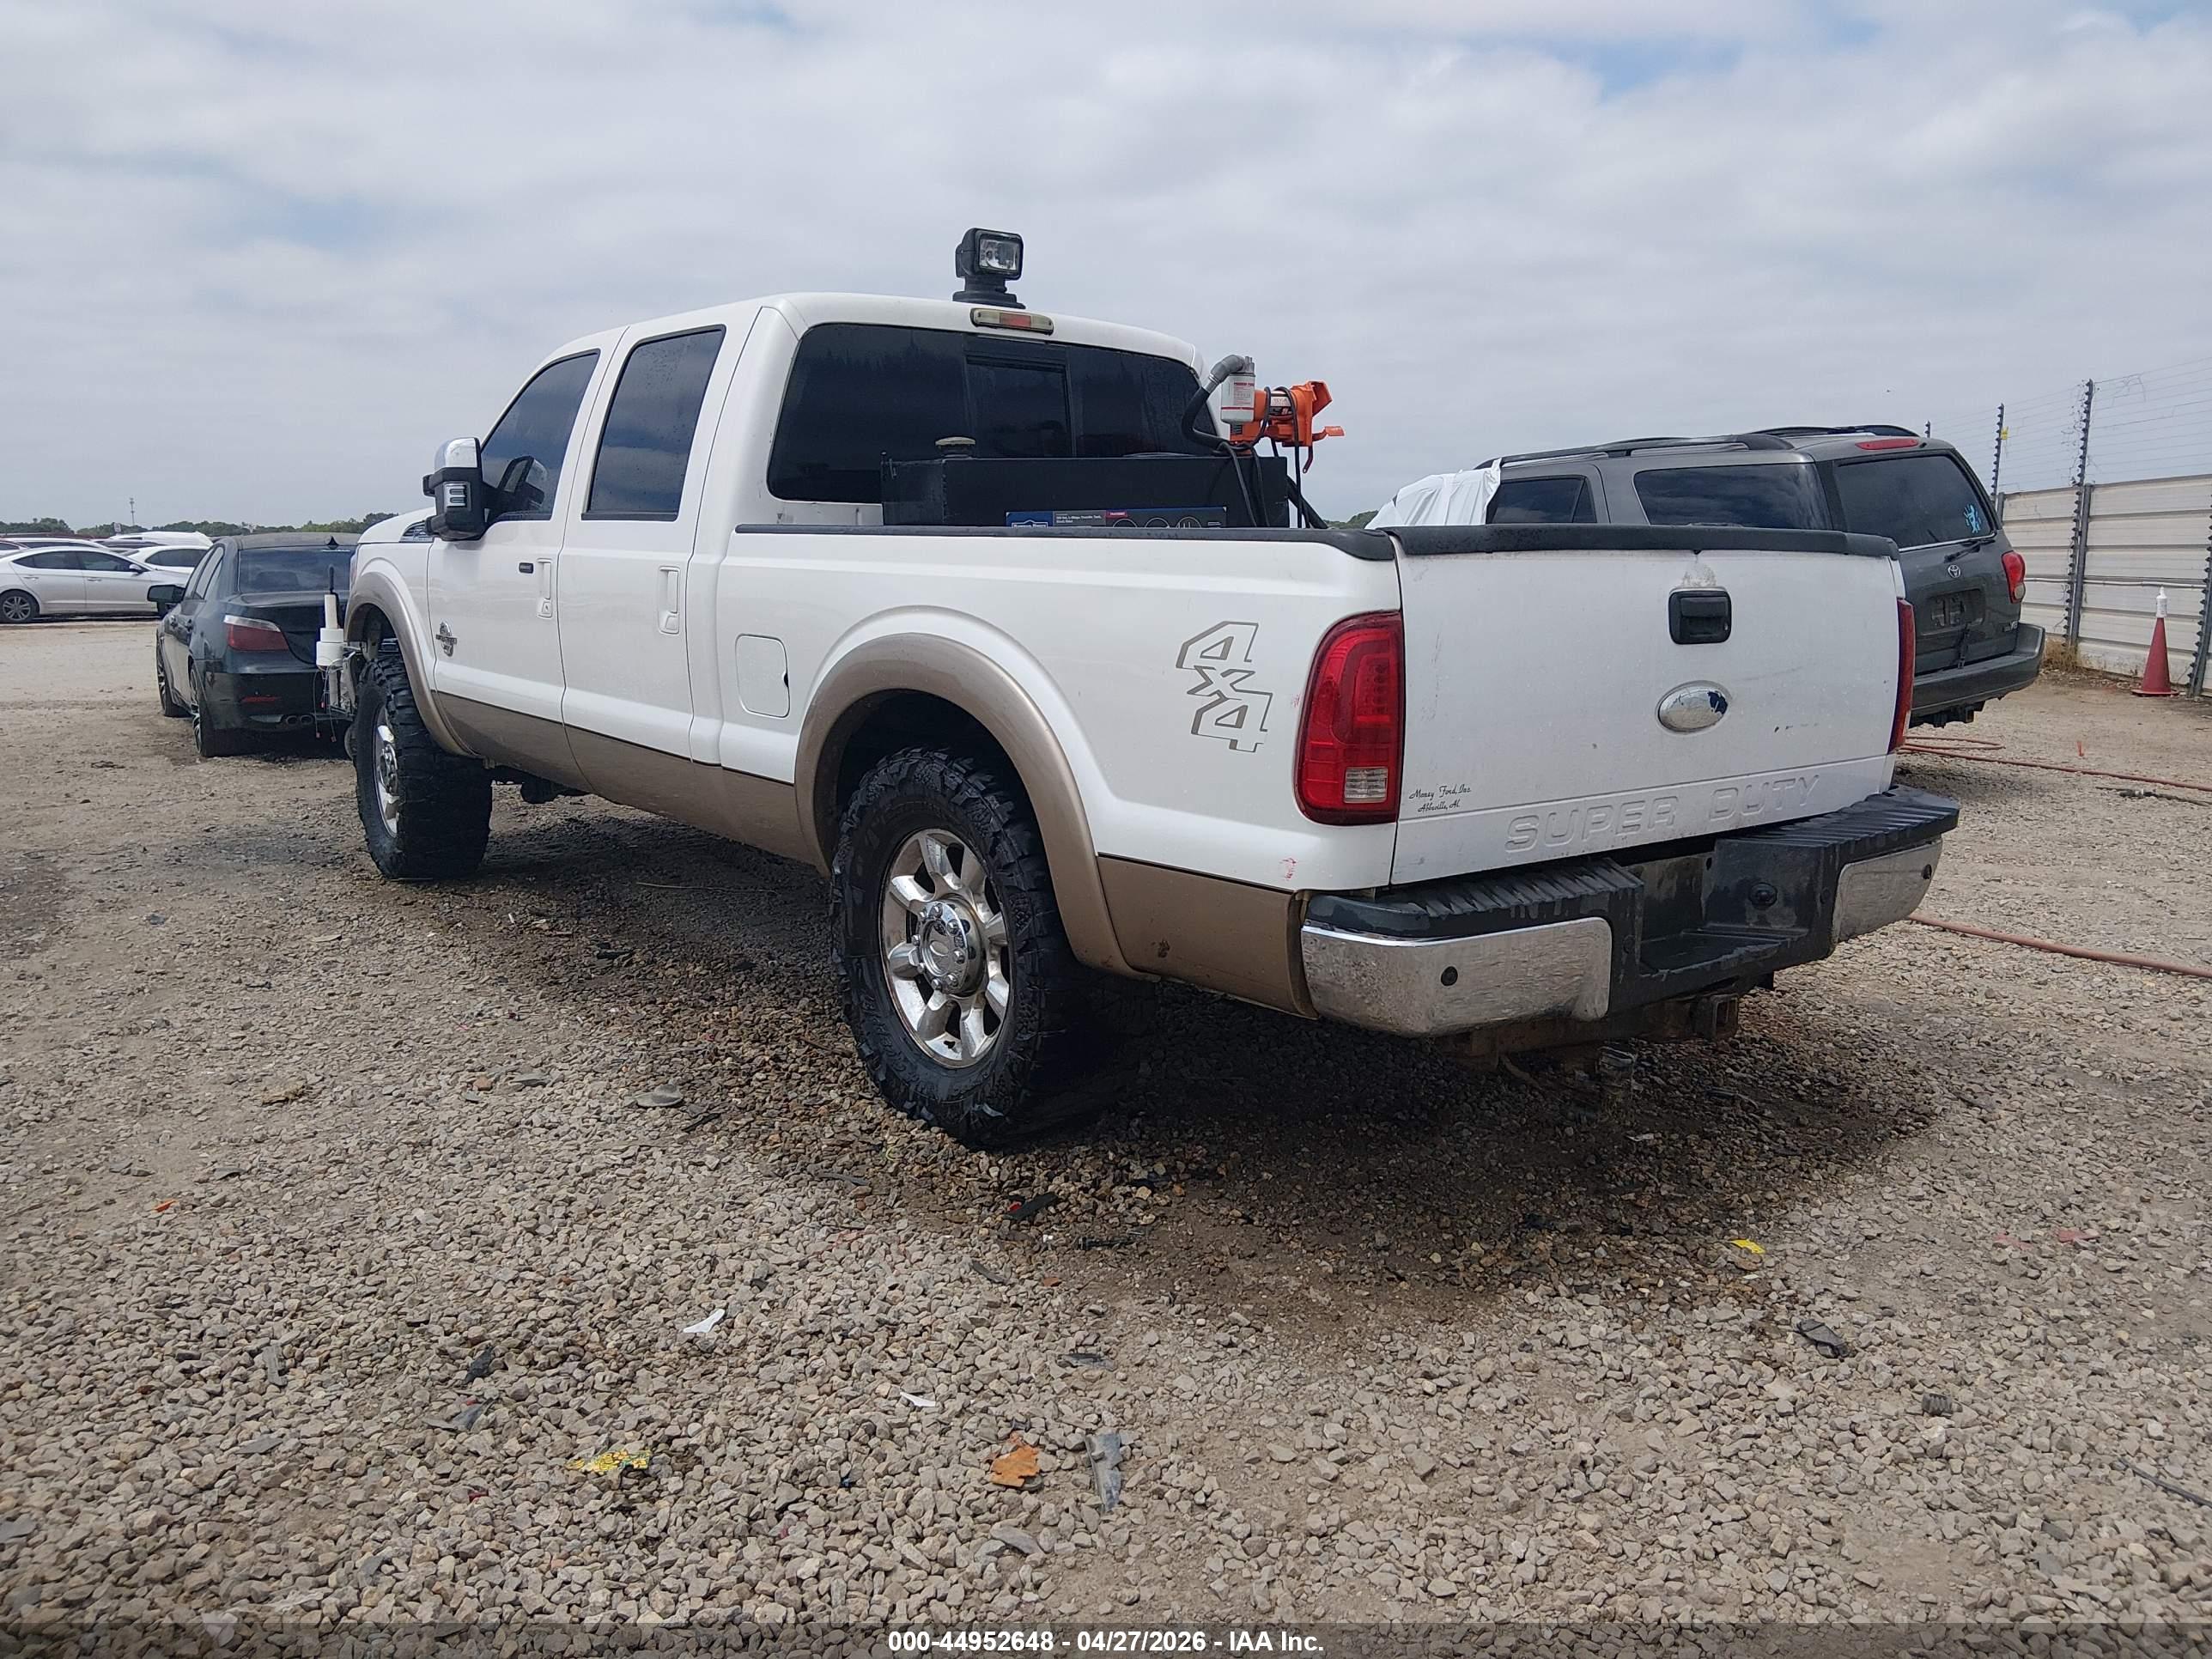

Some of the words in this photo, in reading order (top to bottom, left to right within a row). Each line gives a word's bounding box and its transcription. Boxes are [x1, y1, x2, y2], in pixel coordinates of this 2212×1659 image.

[1438, 784, 1457, 798] Ford,
[1504, 795, 1679, 853] SUPER
[1709, 775, 1820, 822] DUTY
